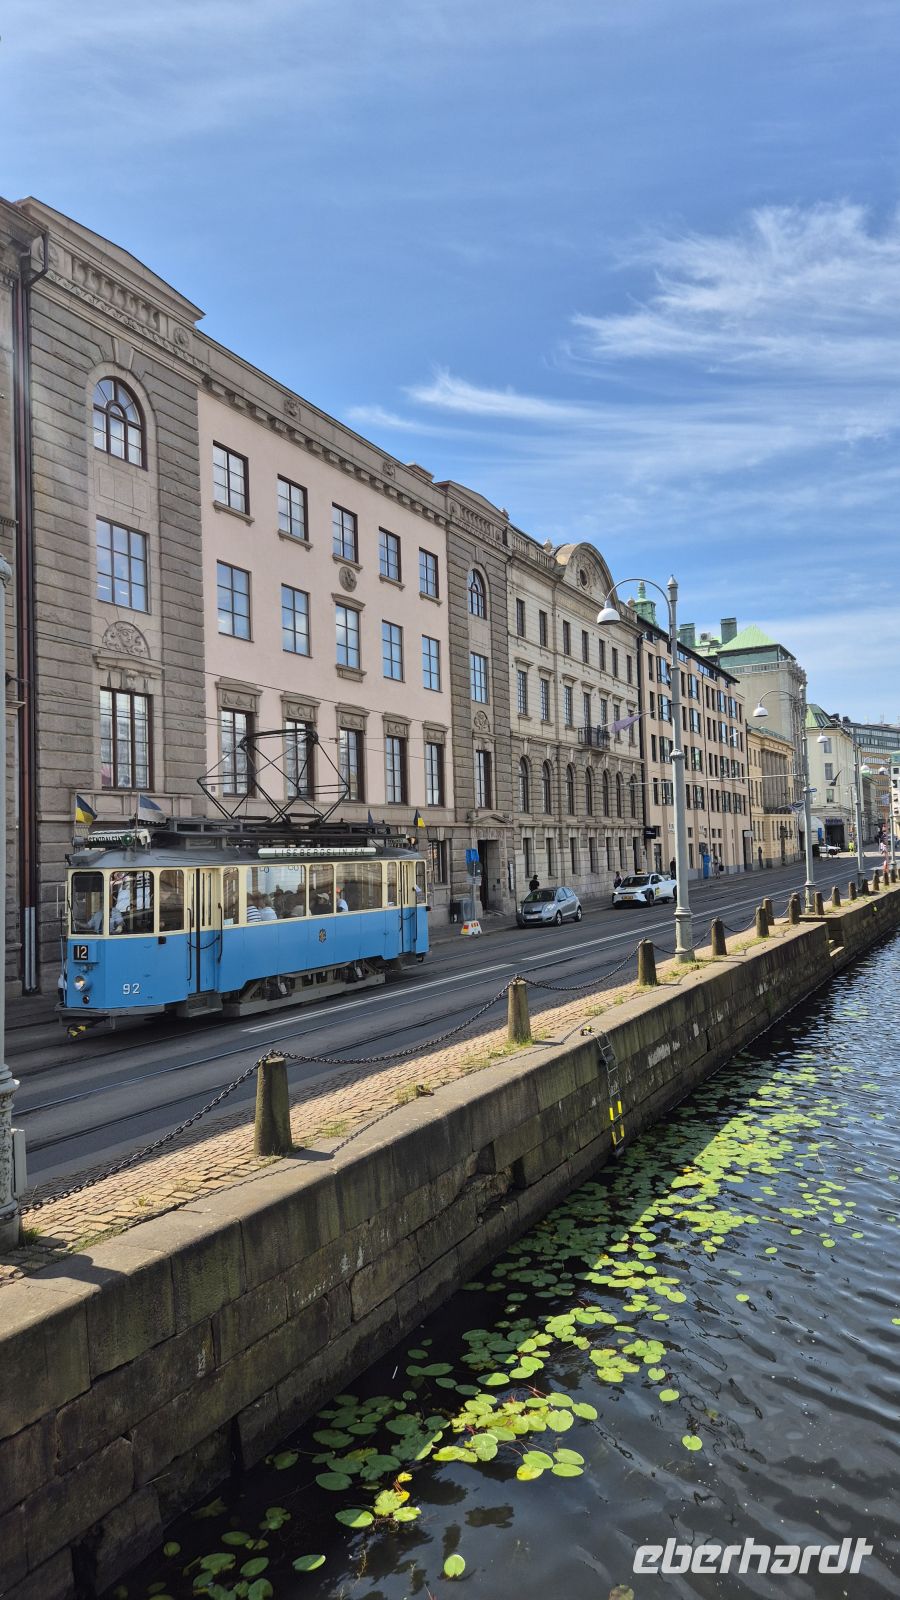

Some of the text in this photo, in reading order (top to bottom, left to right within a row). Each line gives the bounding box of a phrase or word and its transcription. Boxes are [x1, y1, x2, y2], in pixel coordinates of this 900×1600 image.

[274, 848, 365, 858] LISEBERGSLINJEN
[76, 945, 88, 959] 12
[122, 983, 141, 995] 92
